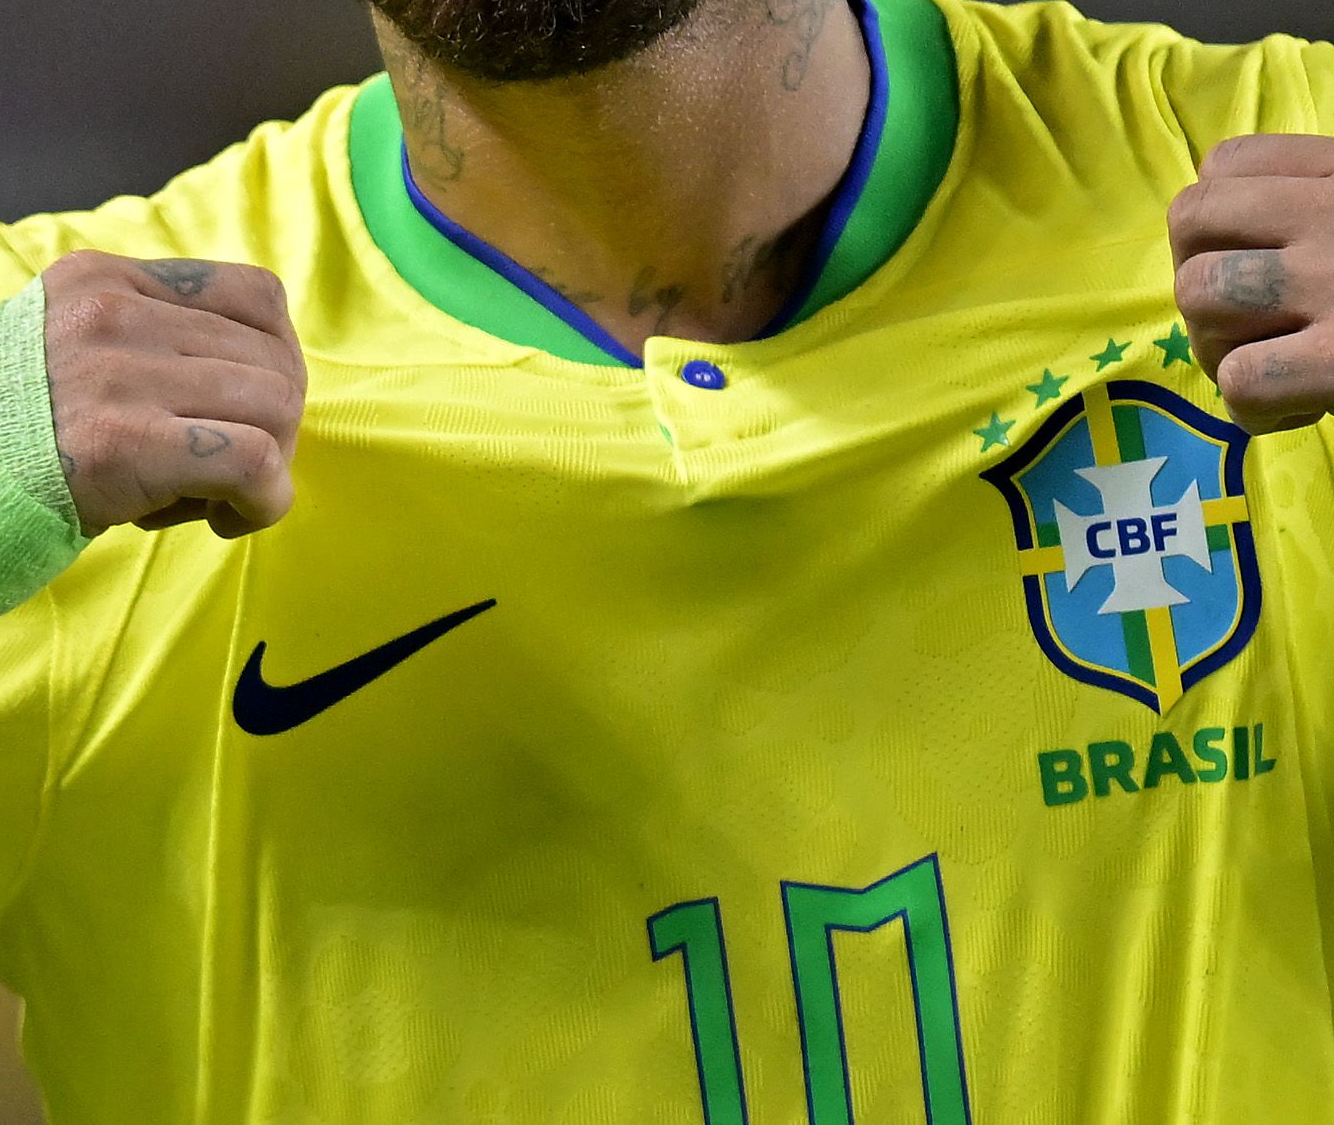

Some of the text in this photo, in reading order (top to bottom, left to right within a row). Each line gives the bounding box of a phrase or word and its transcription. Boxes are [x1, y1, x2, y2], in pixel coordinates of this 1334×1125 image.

[1086, 512, 1178, 559] CBF
[1038, 723, 1277, 807] BRASIL
[646, 852, 972, 1125] 10
